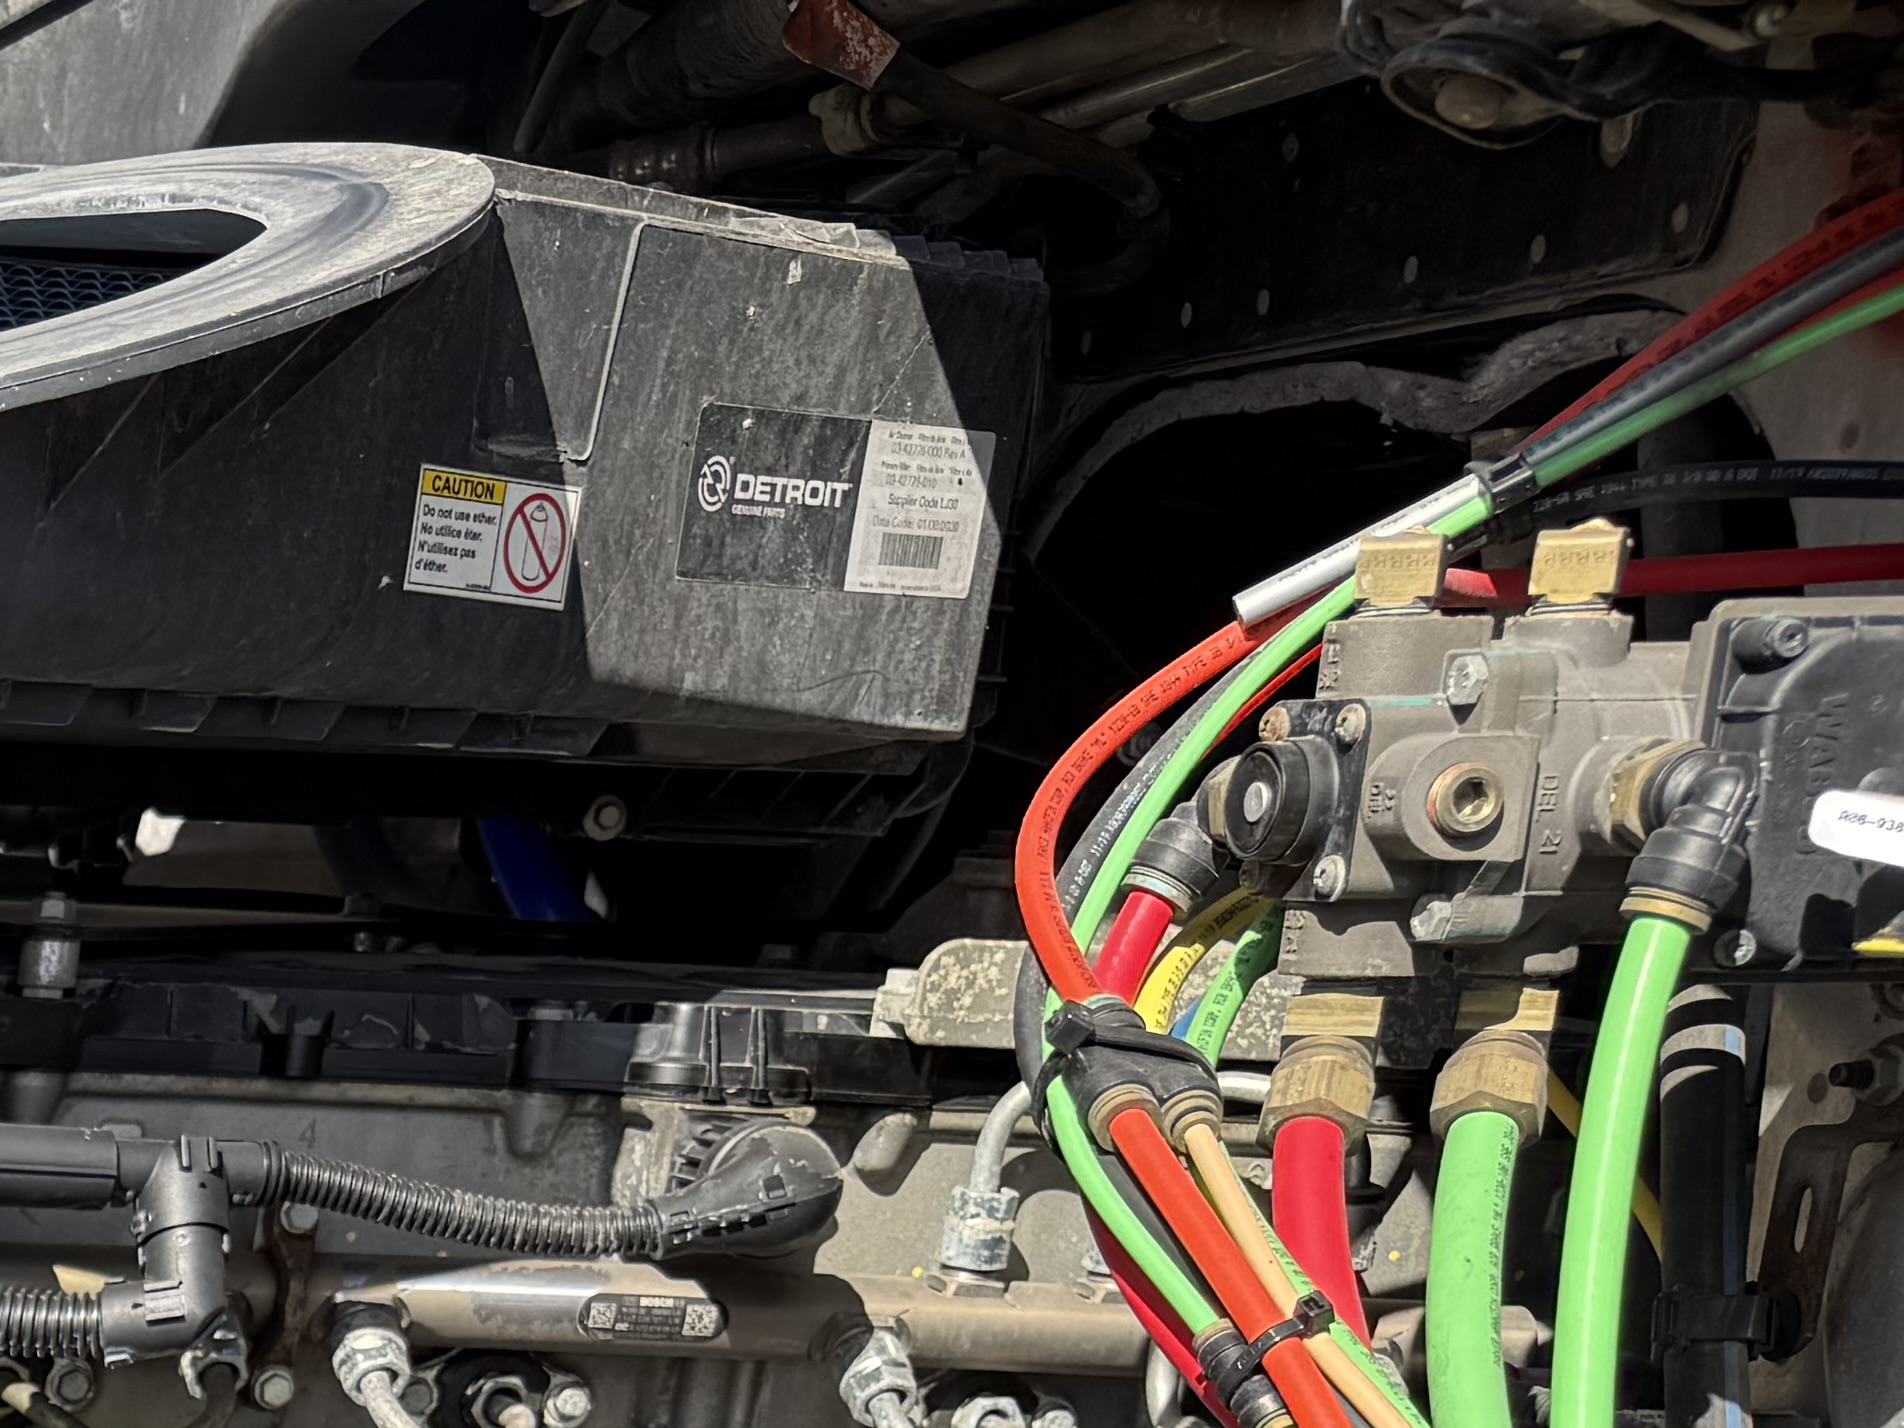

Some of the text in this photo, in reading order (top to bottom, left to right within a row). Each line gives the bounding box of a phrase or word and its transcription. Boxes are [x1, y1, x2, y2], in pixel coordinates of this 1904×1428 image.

[432, 475, 495, 500] CAUTION
[734, 473, 850, 508] DETROIT
[423, 504, 435, 516] Do
[438, 505, 452, 520] not
[454, 511, 470, 521] use
[420, 522, 433, 536] No
[459, 548, 476, 560] pas
